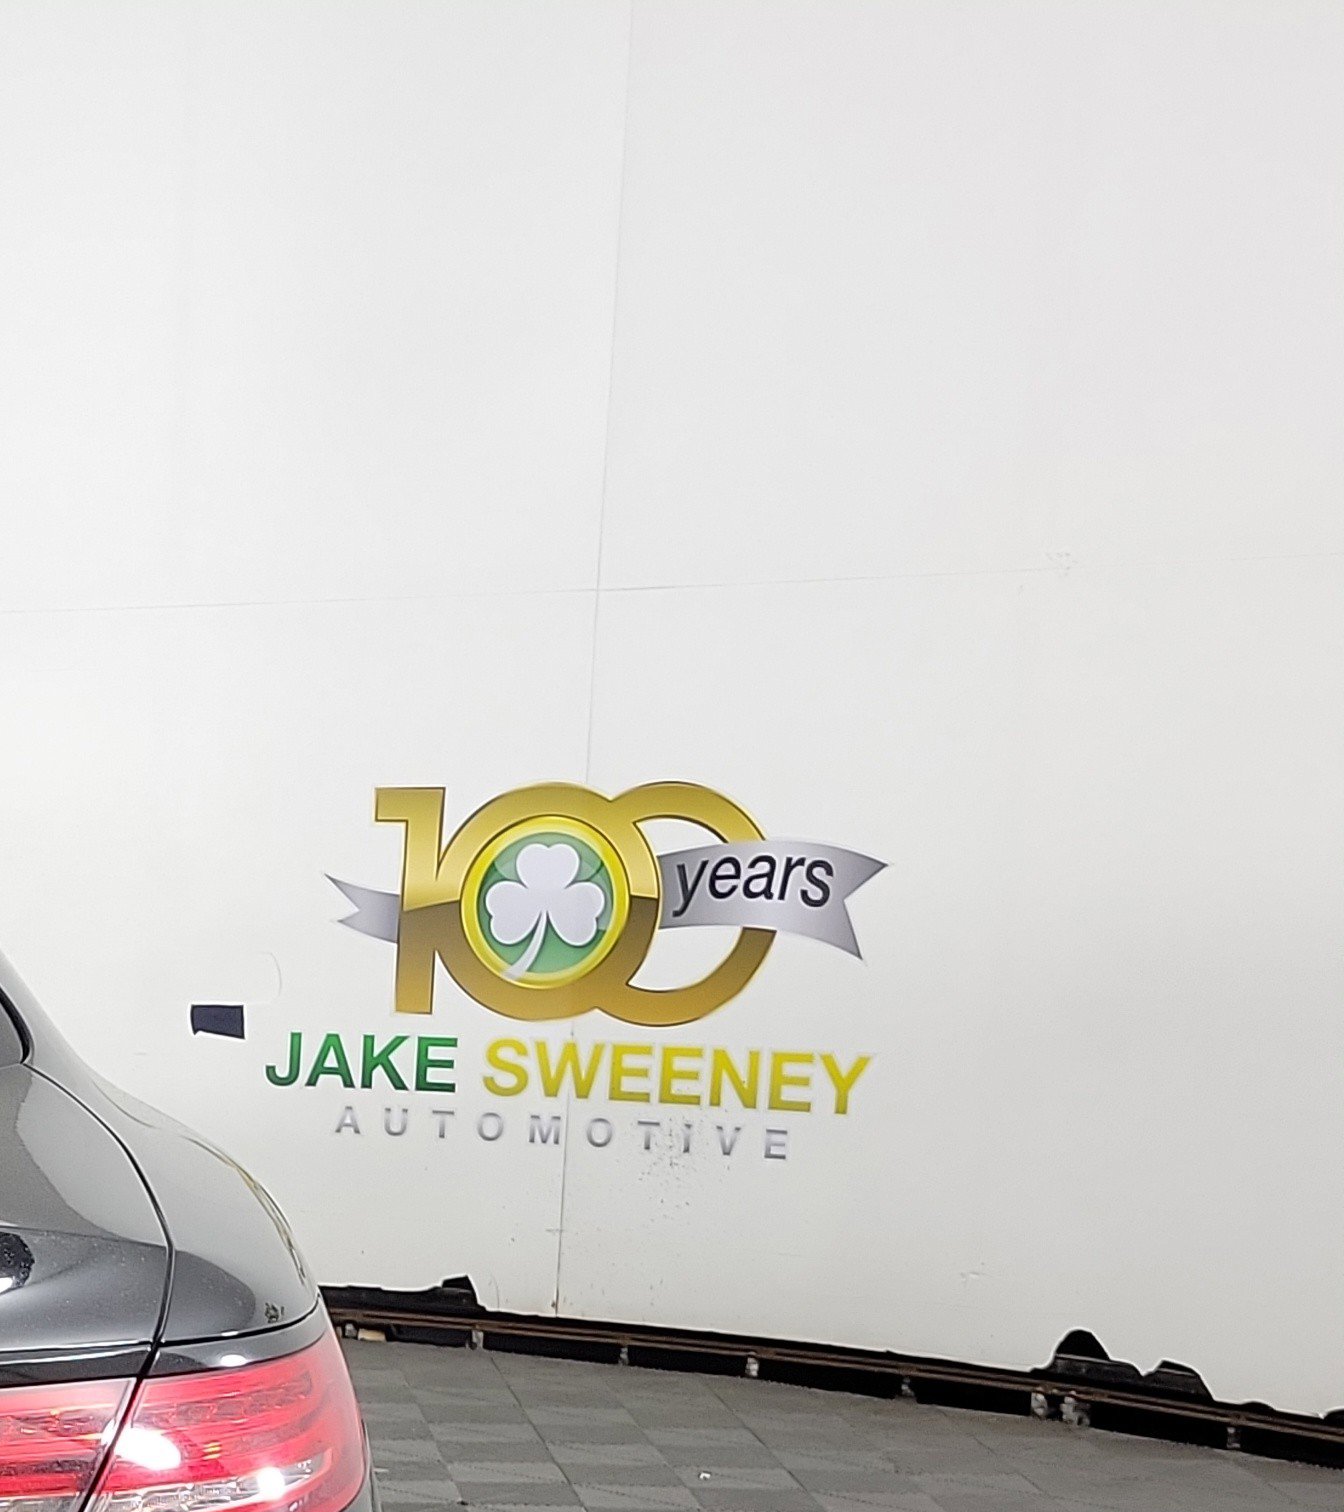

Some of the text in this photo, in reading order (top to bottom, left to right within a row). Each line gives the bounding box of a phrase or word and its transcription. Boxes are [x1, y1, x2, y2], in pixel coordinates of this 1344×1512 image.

[374, 781, 835, 1027] 100 years
[265, 1031, 871, 1115] JAKE SWEENEY
[334, 1106, 789, 1161] AUTOMOTIVE
